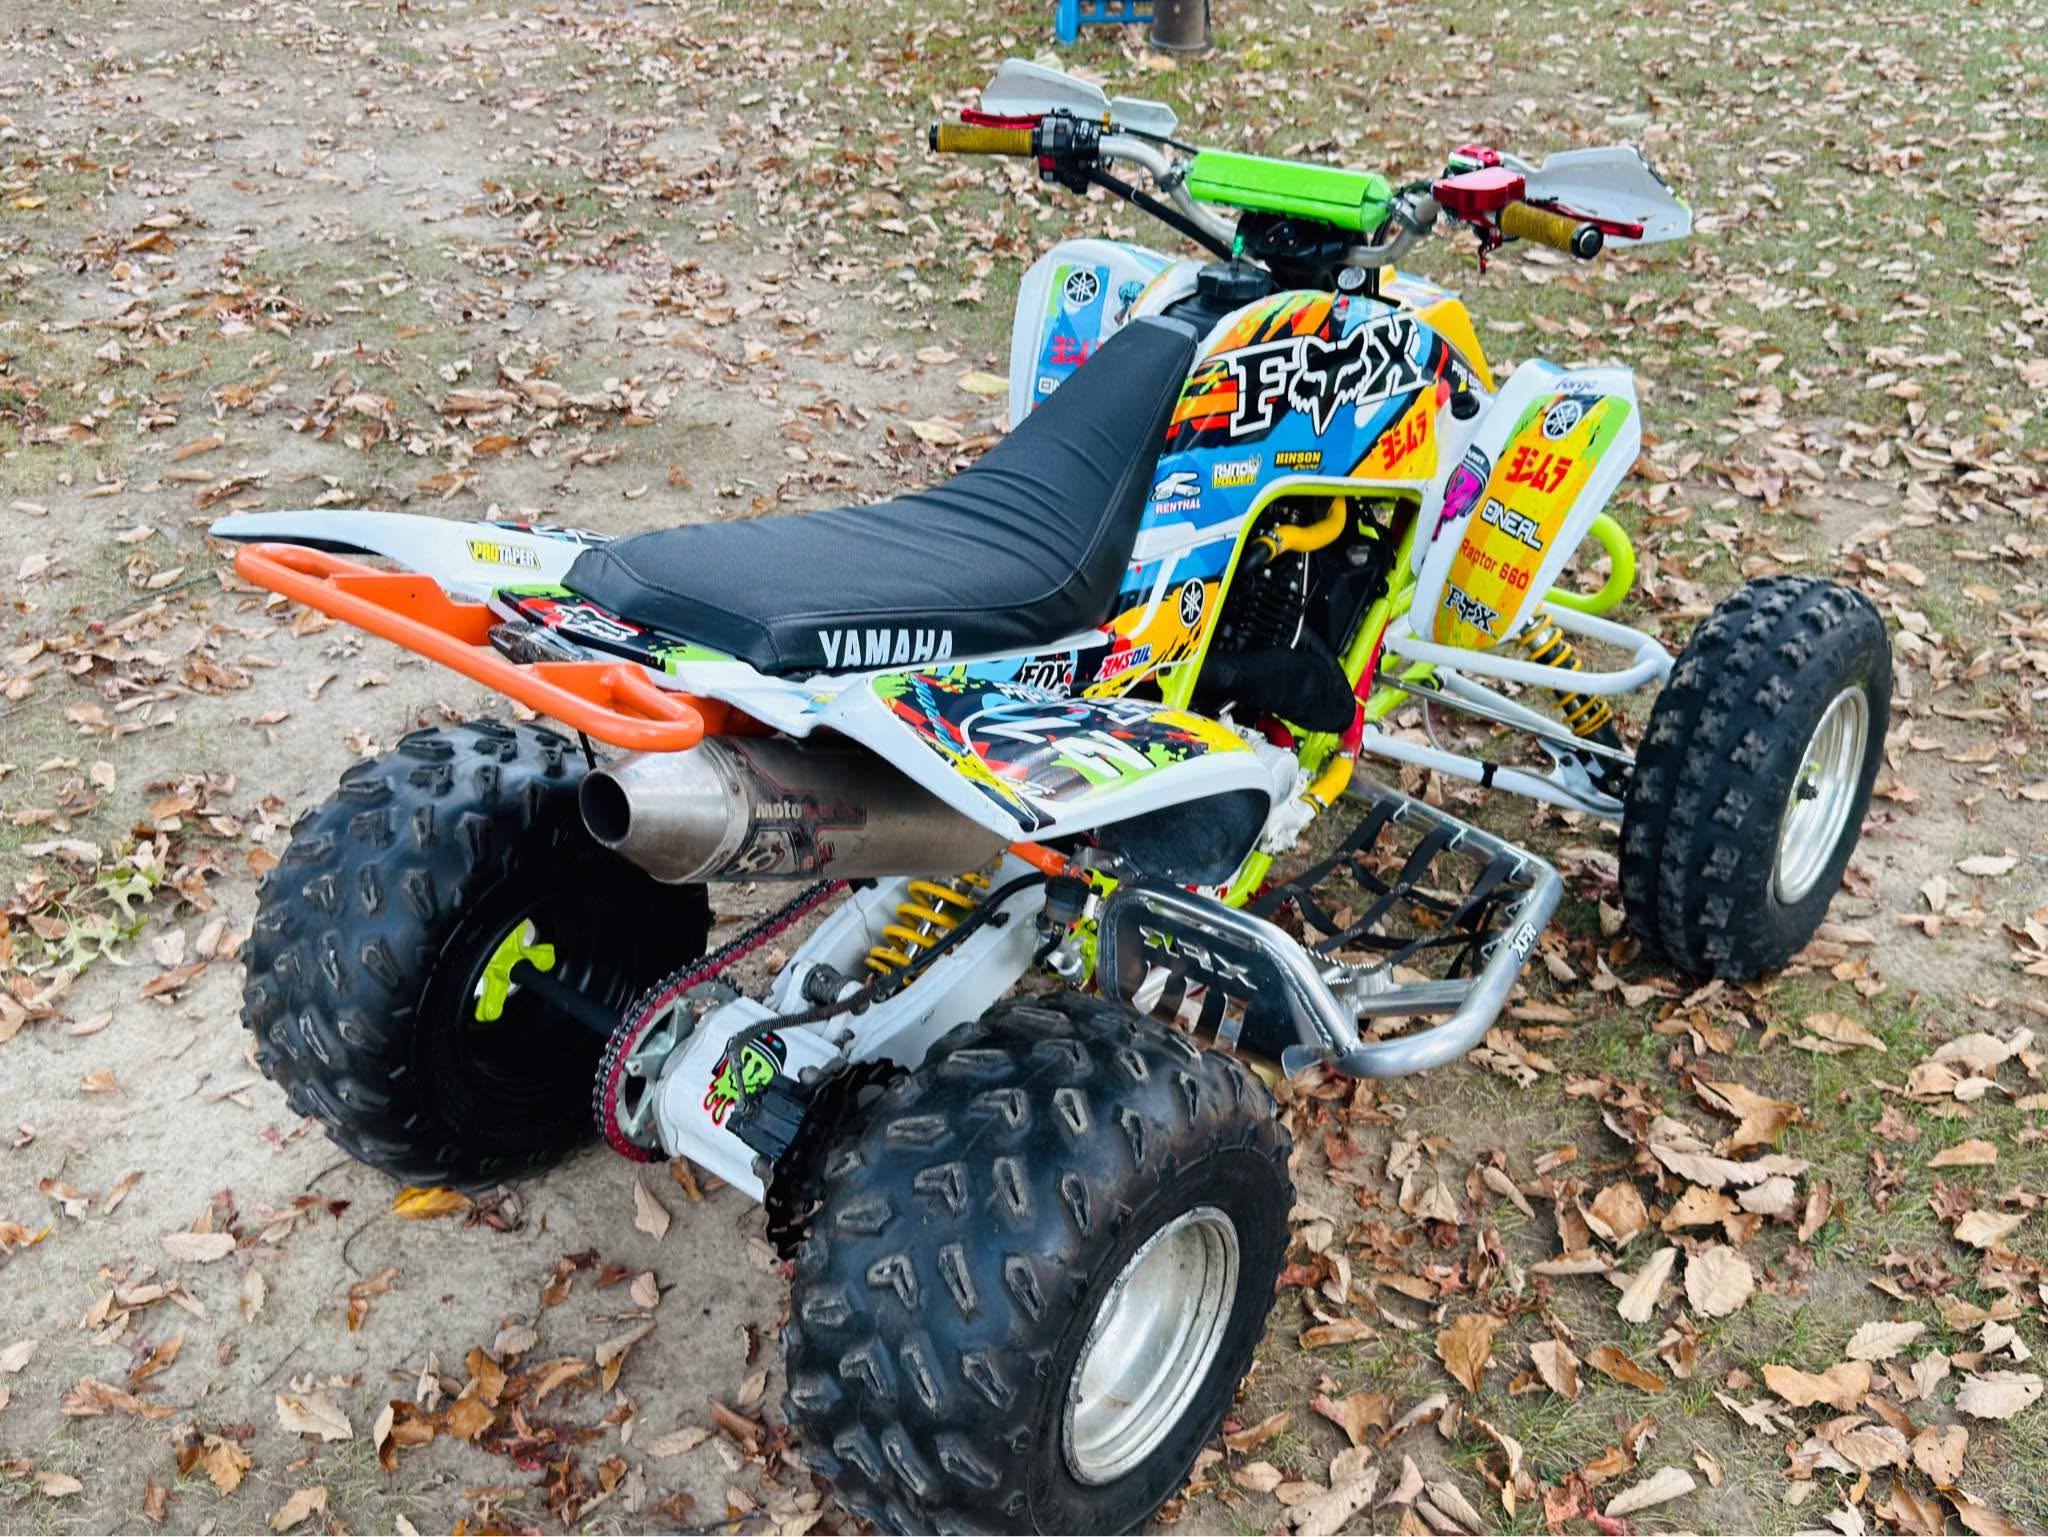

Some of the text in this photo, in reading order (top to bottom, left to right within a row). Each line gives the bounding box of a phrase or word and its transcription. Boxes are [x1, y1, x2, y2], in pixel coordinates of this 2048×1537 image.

[1228, 310, 1434, 438] FOX
[1275, 451, 1321, 464] HINSON
[1155, 498, 1201, 515] RENTHAL
[1480, 496, 1543, 551] ONEAL
[1461, 538, 1530, 591] Raptor 660
[818, 628, 953, 669] YAMAHA
[1101, 645, 1151, 679] AMSOIL
[1021, 660, 1073, 692] FOX
